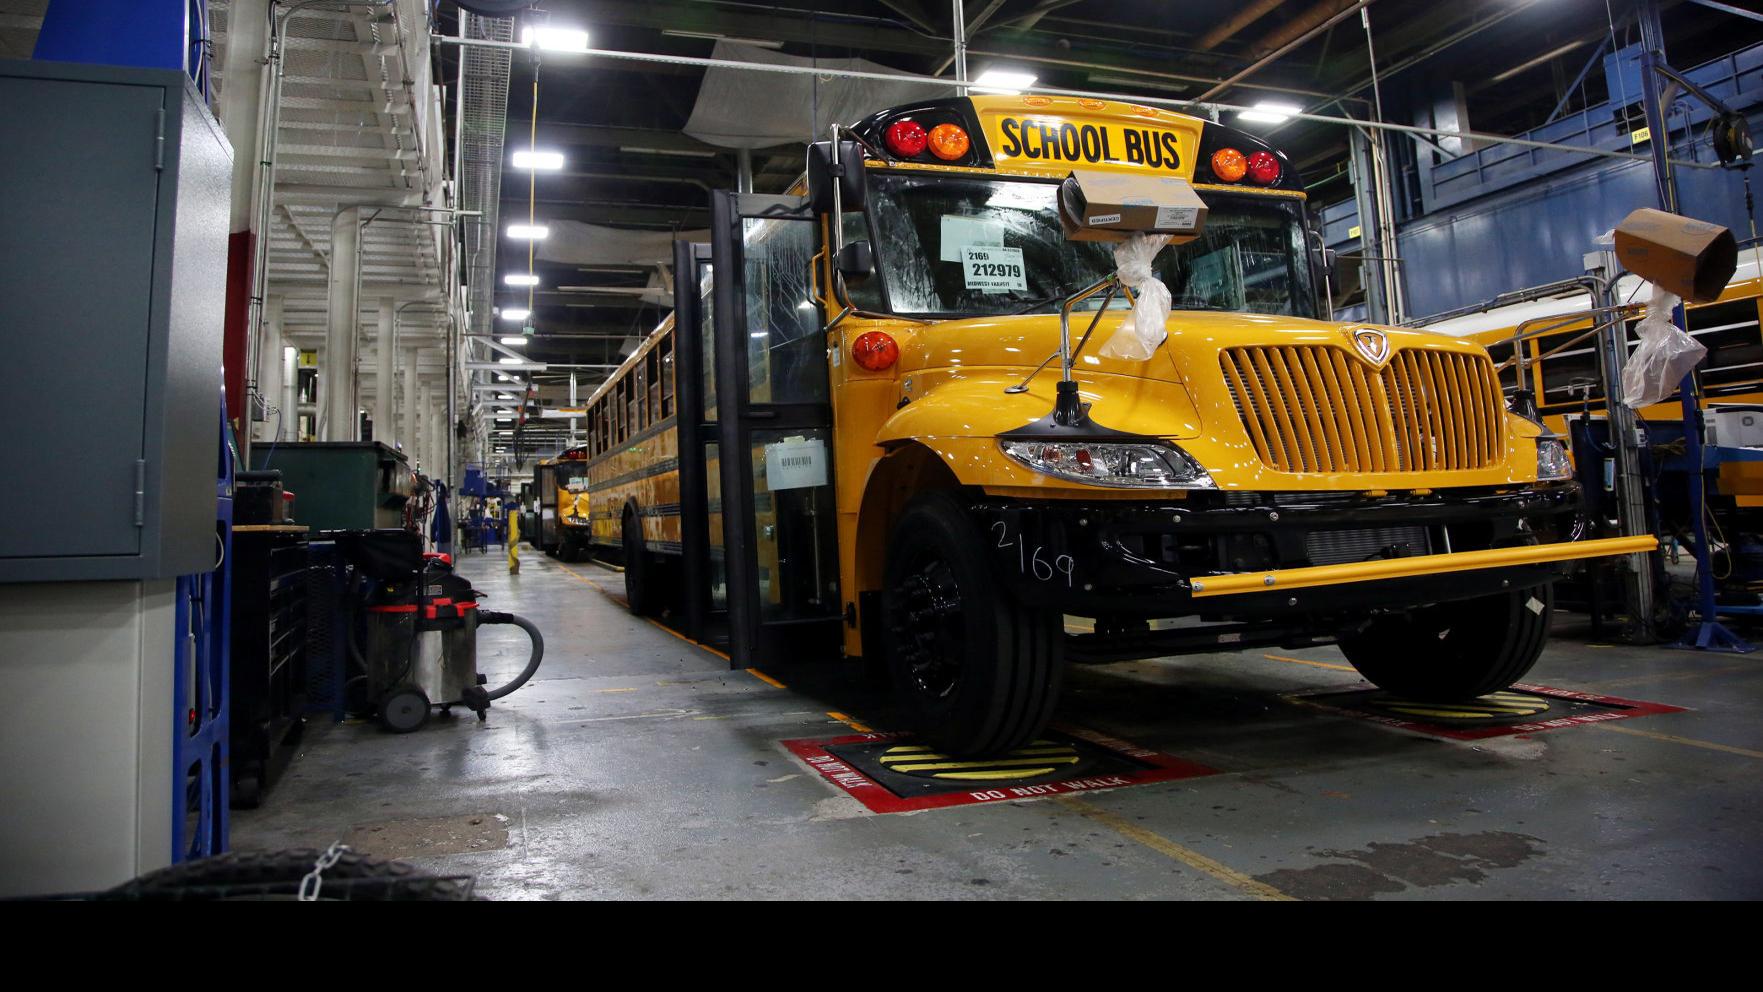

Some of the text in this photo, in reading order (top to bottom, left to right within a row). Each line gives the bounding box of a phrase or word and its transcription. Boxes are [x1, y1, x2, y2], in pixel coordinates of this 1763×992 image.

[1001, 117, 1180, 170] SCHOOL BUS
[968, 251, 990, 261] 2169
[972, 262, 1021, 278] 212979
[991, 521, 1074, 588] 2169
[815, 762, 850, 773] NOT
[969, 776, 1130, 801] DO NOT WALK
